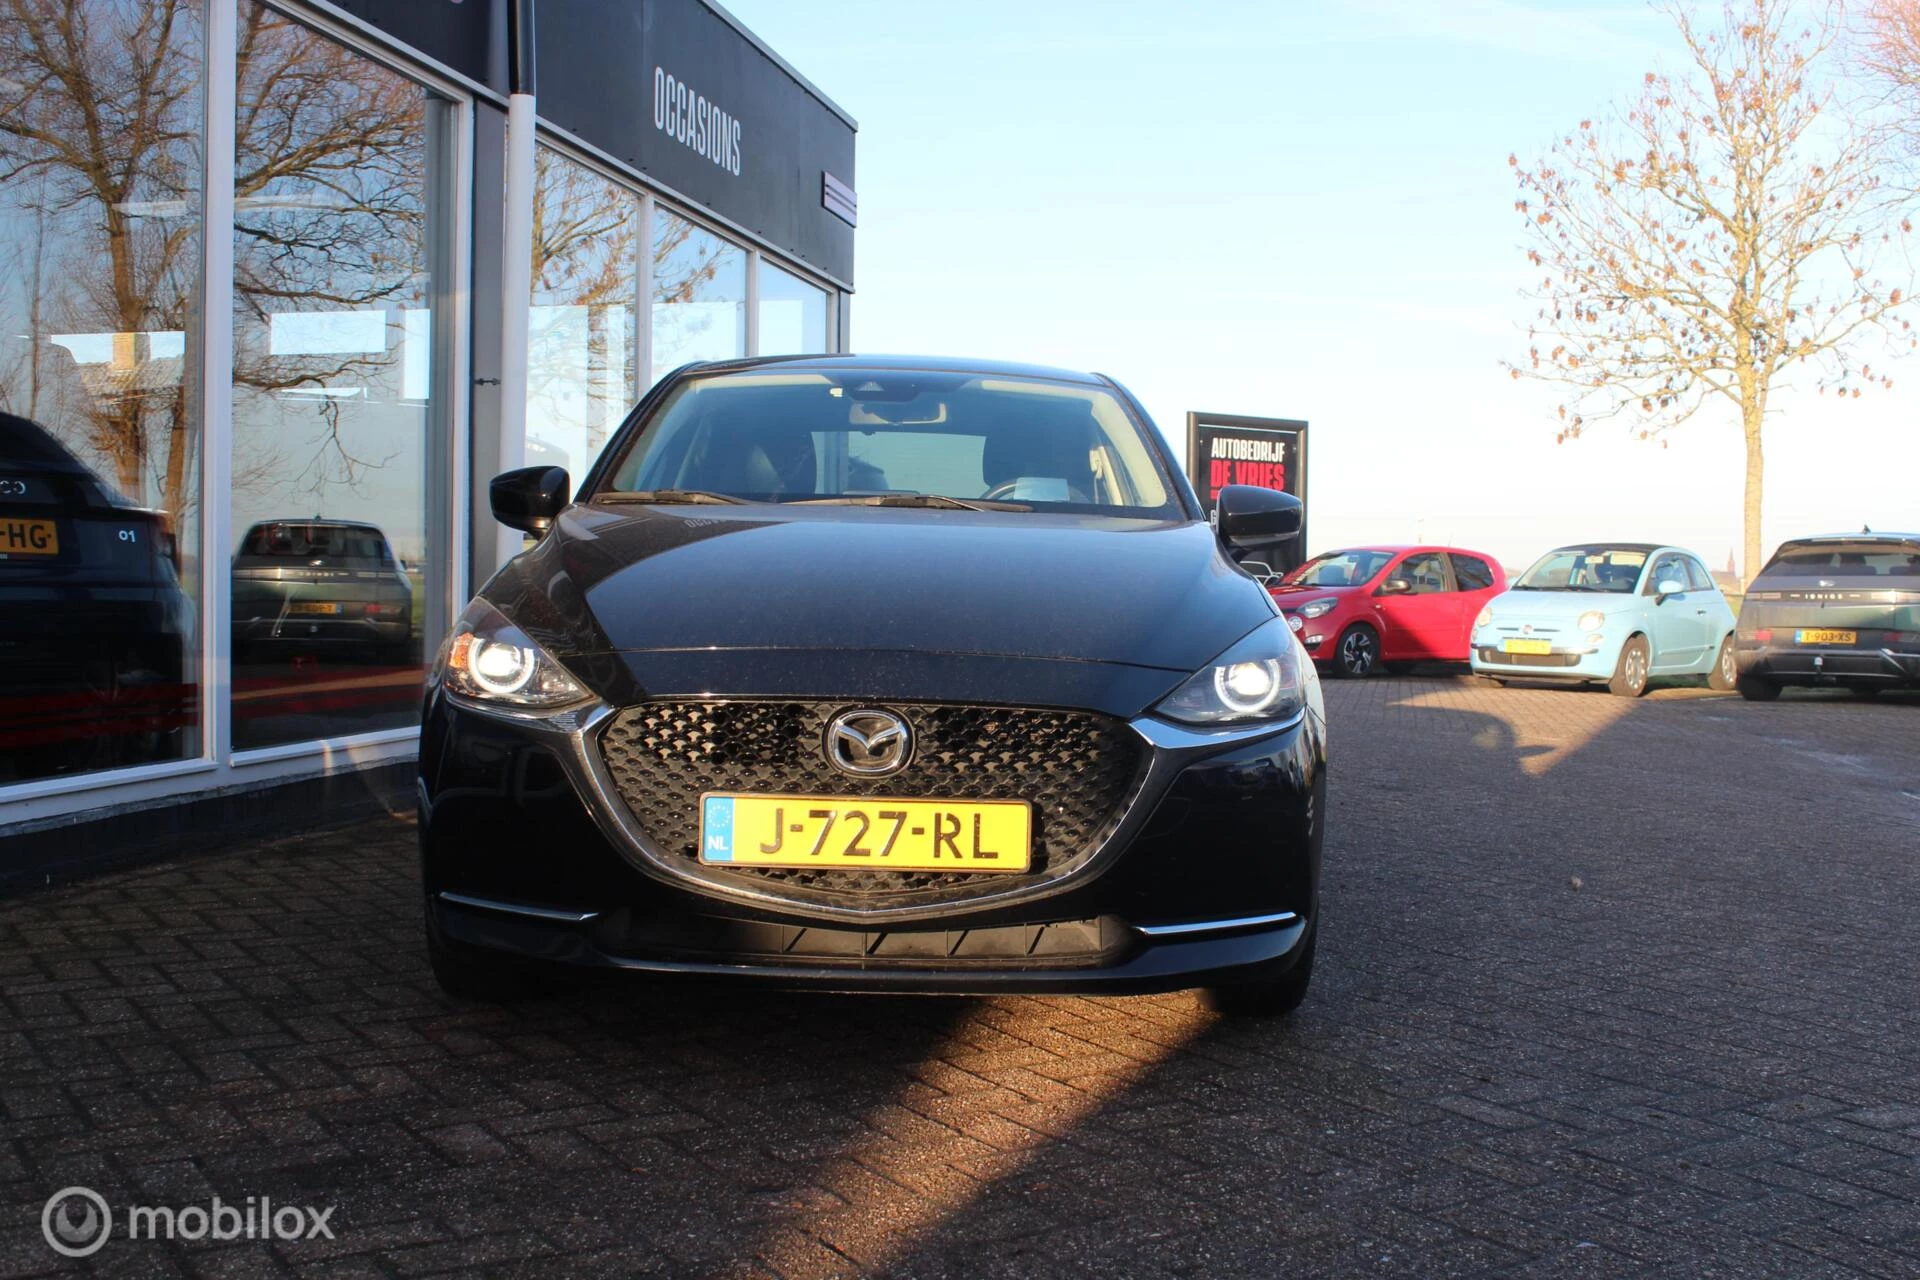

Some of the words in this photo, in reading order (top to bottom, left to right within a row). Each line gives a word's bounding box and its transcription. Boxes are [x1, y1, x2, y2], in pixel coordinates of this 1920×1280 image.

[654, 66, 741, 176] OCCASIONS
[1211, 437, 1285, 462] AUTOBEDRIJF
[1210, 459, 1231, 487] DE
[1236, 462, 1285, 491] VRIES
[118, 530, 136, 543] 01
[708, 836, 728, 851] NL
[759, 808, 999, 860] J-727-RL
